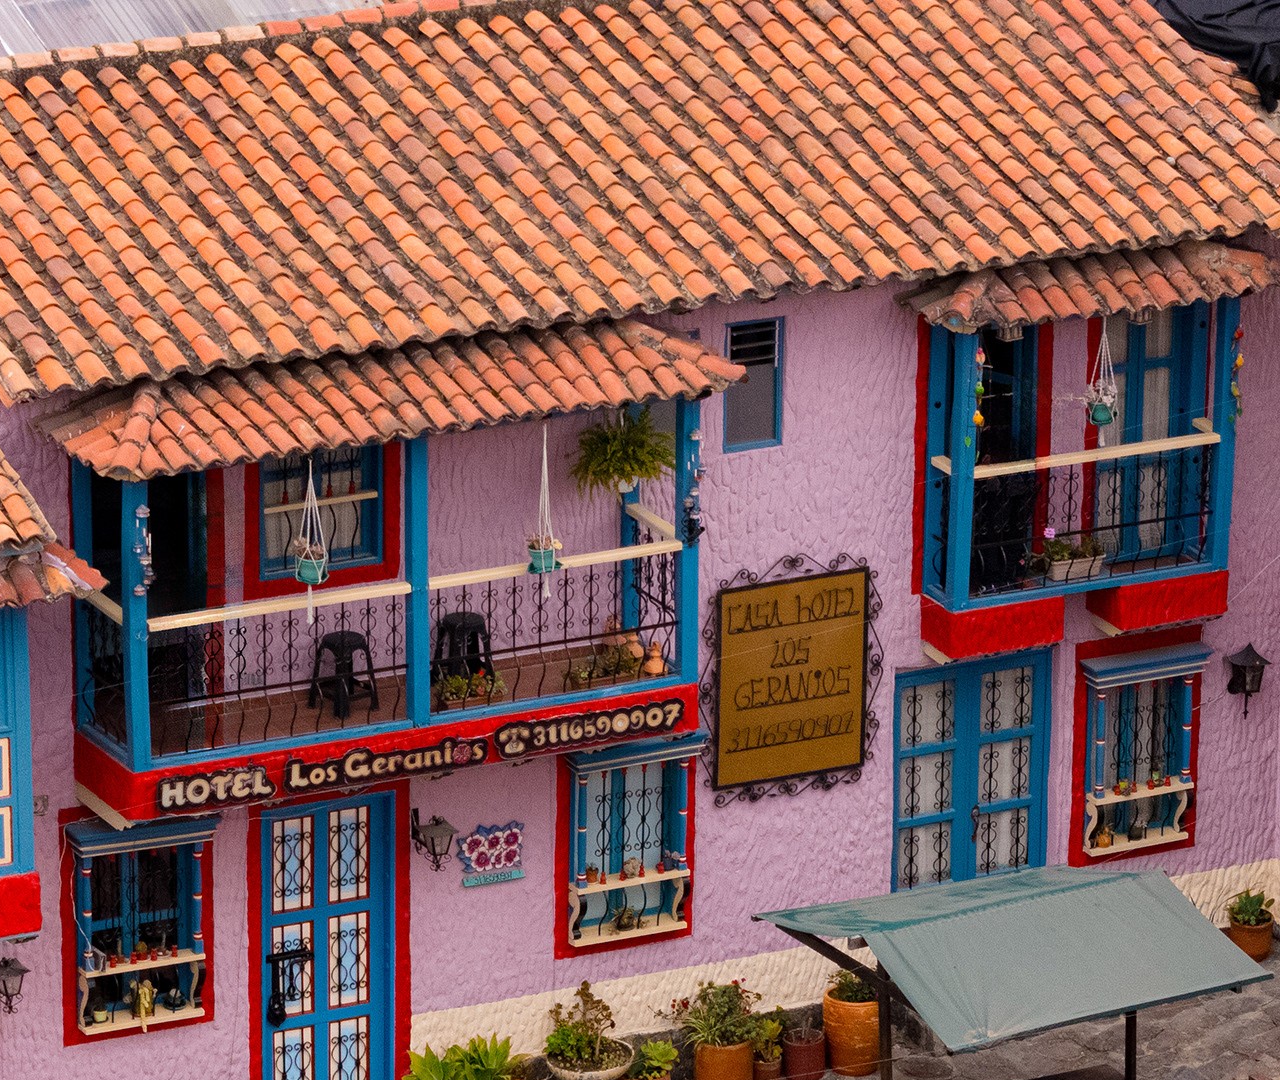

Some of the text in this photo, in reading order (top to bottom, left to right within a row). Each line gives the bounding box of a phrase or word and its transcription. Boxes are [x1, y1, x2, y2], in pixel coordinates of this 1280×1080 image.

[727, 599, 783, 635] CASA
[770, 635, 812, 669] LOS
[726, 710, 855, 754] 3116590907
[161, 770, 272, 808] HOTEL
[289, 762, 338, 789] Los
[532, 702, 682, 747] 3116590907
